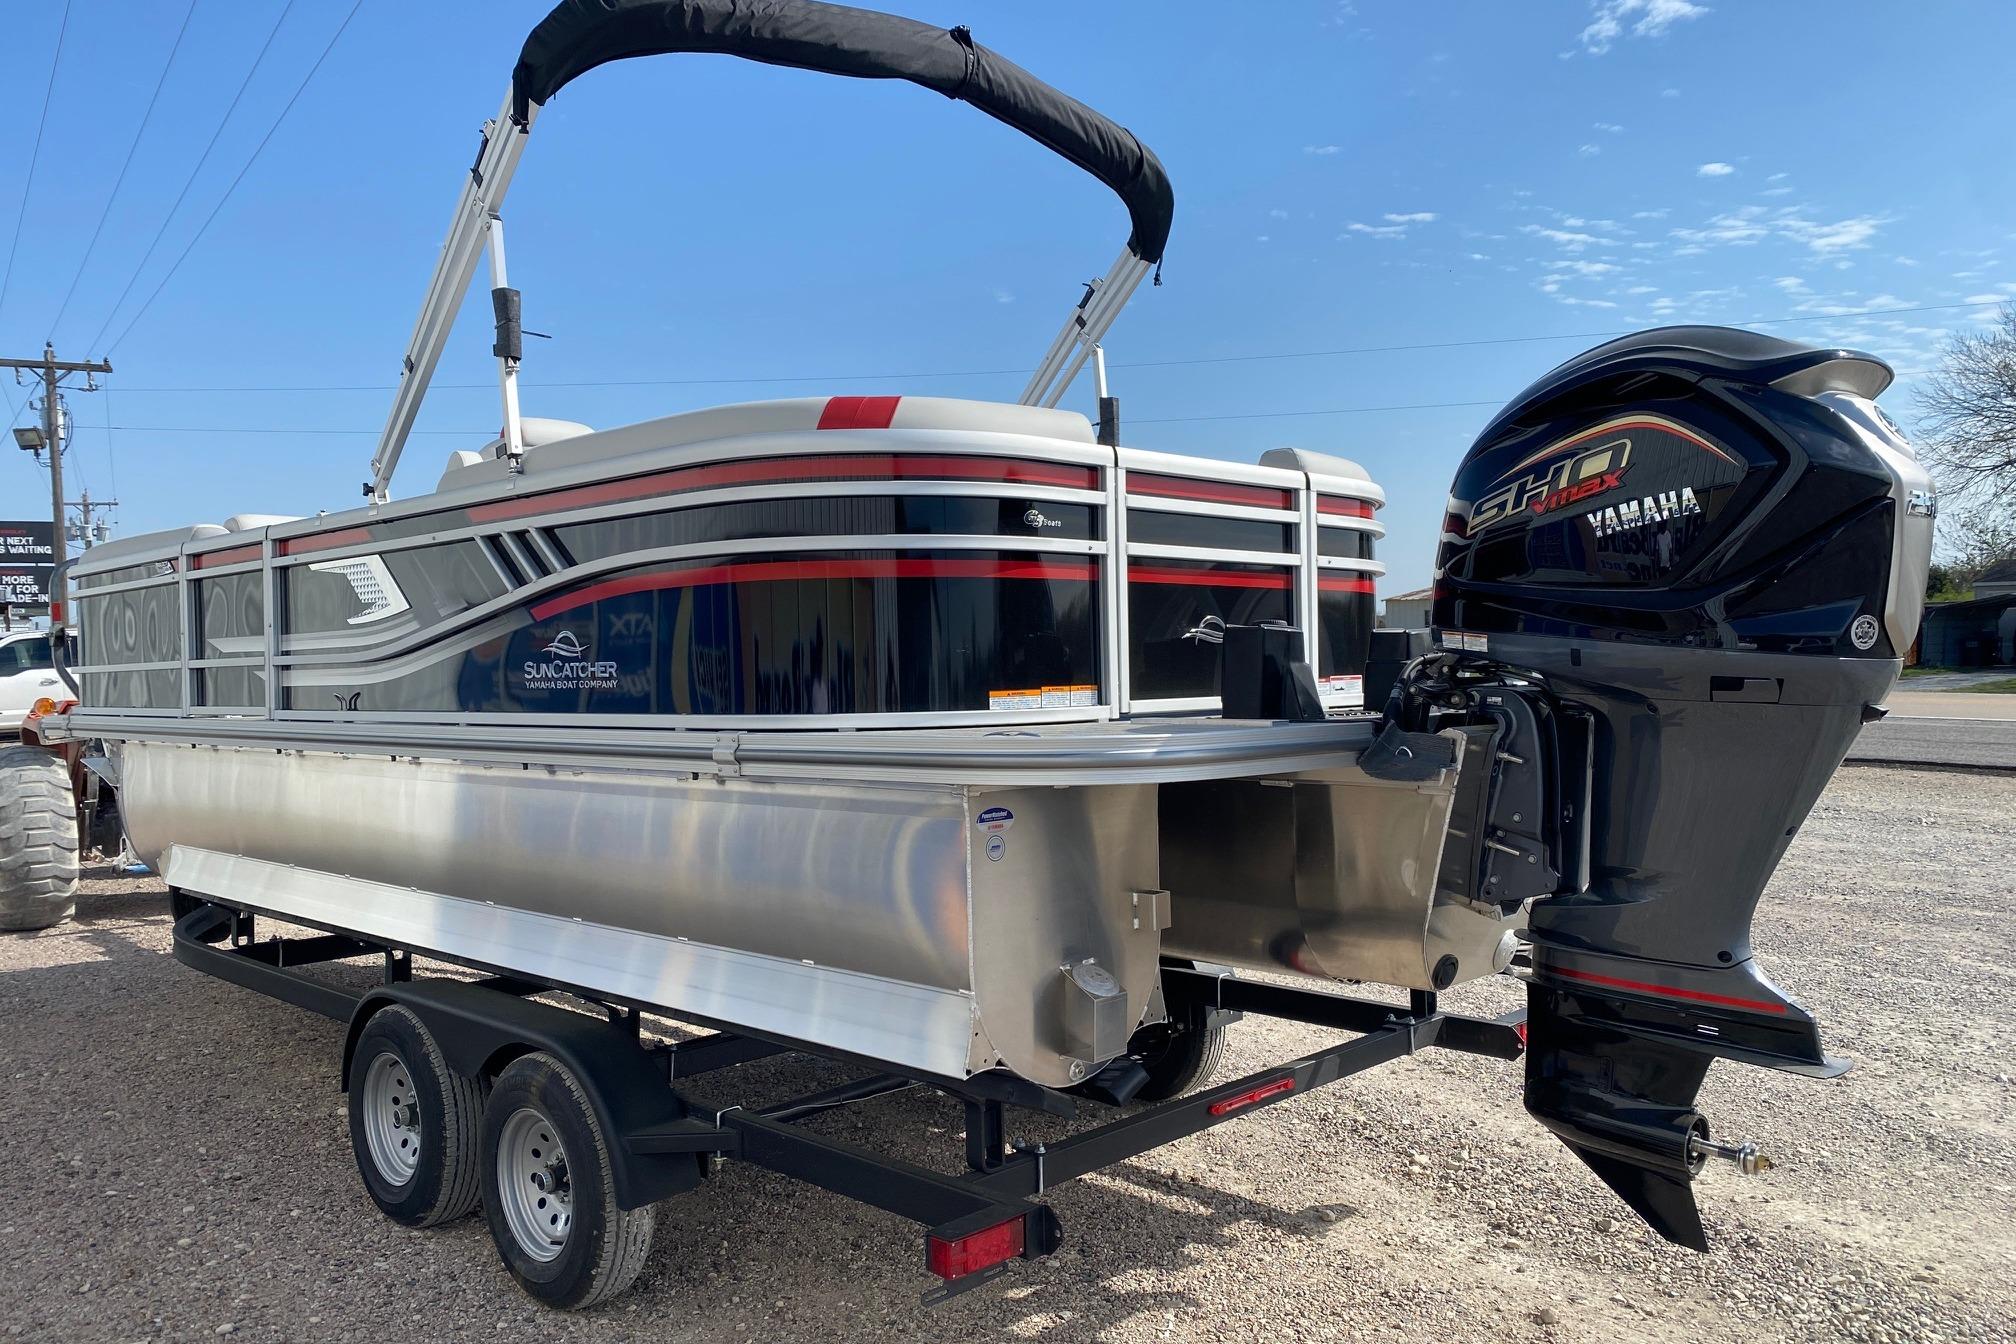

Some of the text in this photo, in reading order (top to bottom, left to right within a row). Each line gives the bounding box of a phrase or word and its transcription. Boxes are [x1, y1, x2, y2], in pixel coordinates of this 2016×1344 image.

[1587, 486, 1700, 538] YAMAHA
[6, 537, 34, 545] NEXT
[8, 546, 52, 554] WAITING
[2, 575, 34, 584] MORE
[16, 585, 39, 594] FOR
[525, 680, 618, 689] YAMAHA BOAT COMPANY
